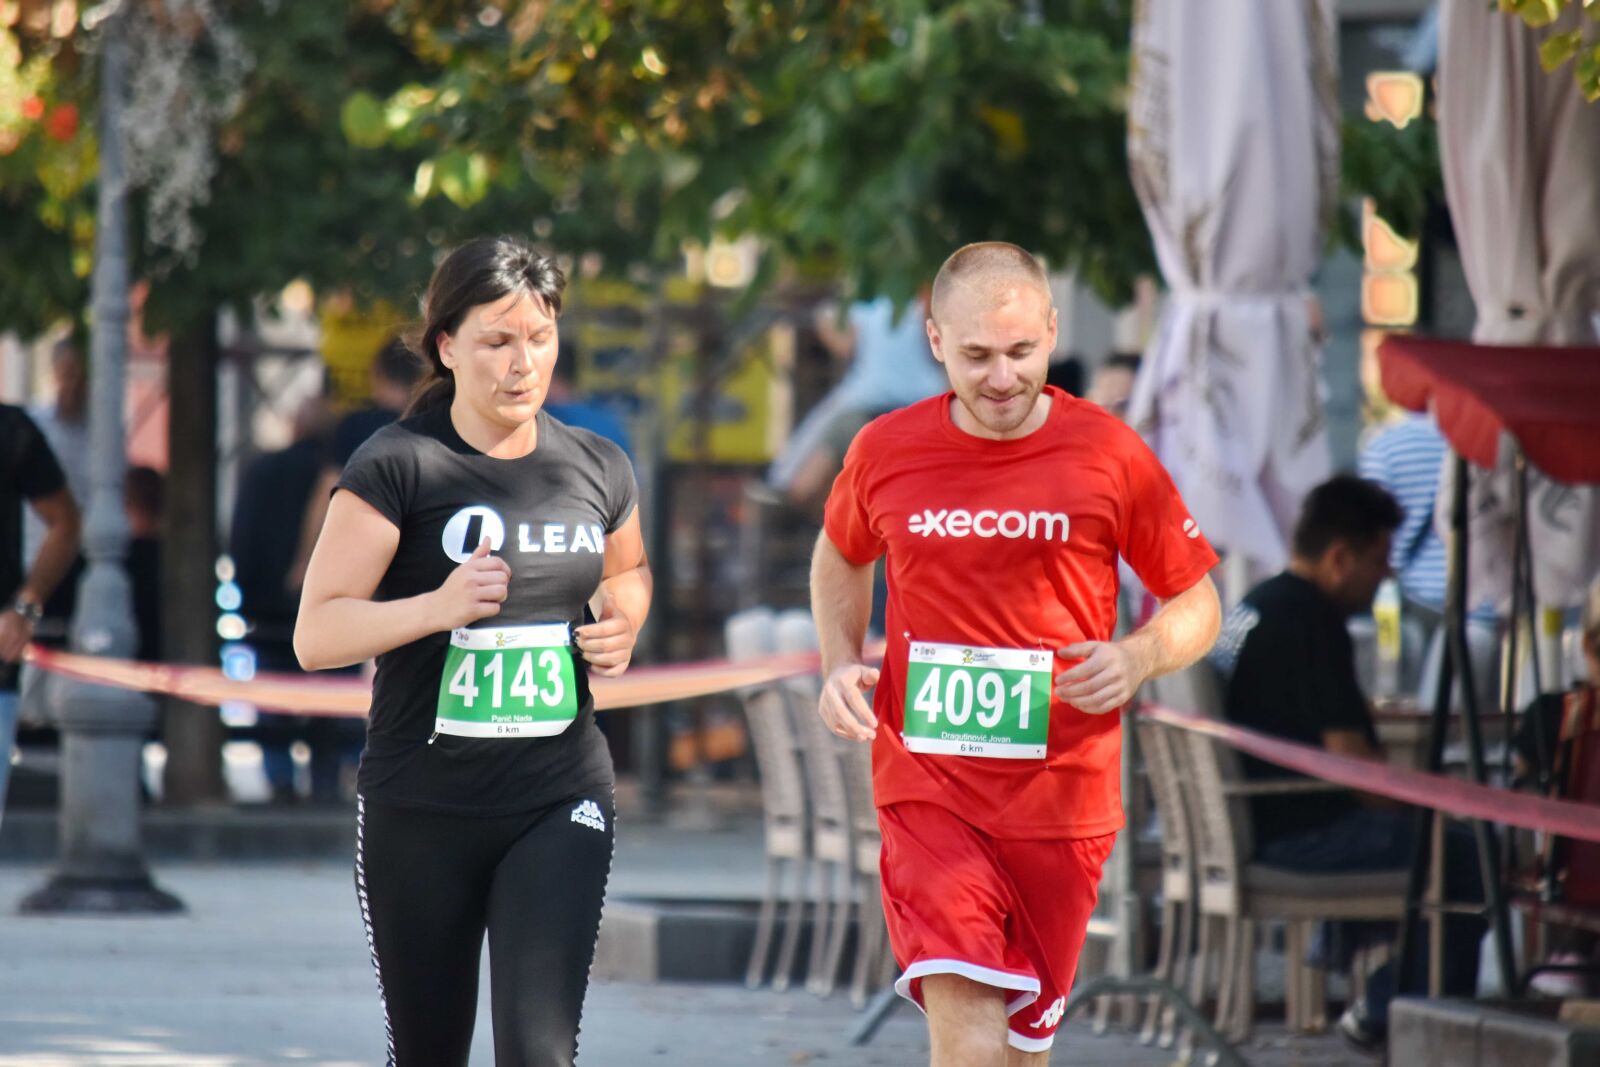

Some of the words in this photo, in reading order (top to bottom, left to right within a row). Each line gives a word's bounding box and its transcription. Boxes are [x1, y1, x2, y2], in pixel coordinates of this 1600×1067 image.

[449, 650, 564, 708] 4143
[914, 667, 1032, 729] 4091
[491, 714, 512, 723] Panić
[513, 714, 533, 722] Nada
[497, 725, 503, 733] 6
[506, 725, 520, 733] km
[941, 731, 987, 743] Dragutinović
[988, 735, 1012, 744] Jovan
[960, 743, 966, 752] 6
[969, 743, 983, 753] km
